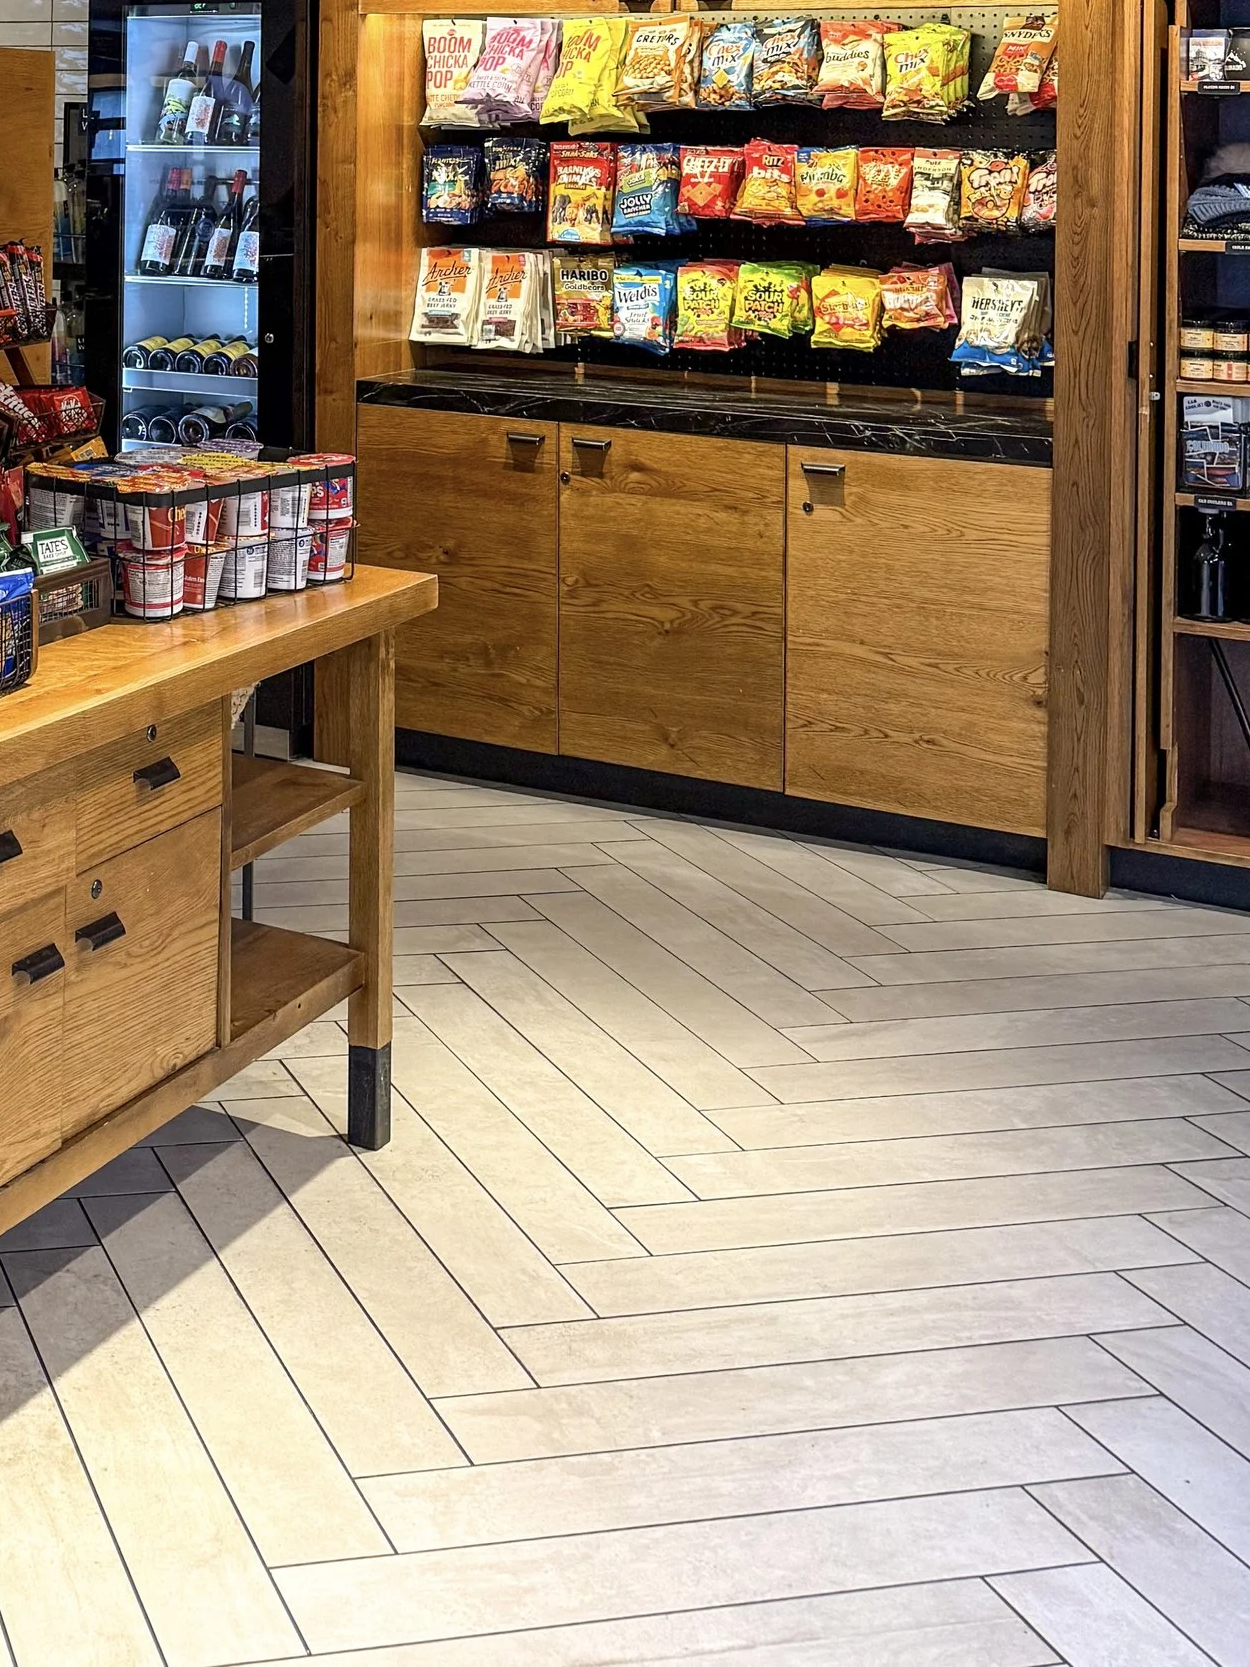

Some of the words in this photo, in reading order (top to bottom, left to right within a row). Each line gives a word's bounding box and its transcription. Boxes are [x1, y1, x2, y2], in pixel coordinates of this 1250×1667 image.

[428, 36, 472, 54] BOOM
[764, 30, 798, 48] Chex
[708, 41, 742, 57] Chex
[825, 49, 870, 63] buddies
[894, 45, 930, 63] Chex
[427, 55, 468, 69] CHICKA
[427, 70, 453, 89] POP
[761, 155, 785, 166] RITZ
[751, 167, 791, 182] bits
[620, 194, 652, 208] JOLLY
[423, 261, 474, 285] Archer
[487, 267, 528, 290] Archer
[561, 269, 608, 281] HARIBO
[565, 283, 605, 291] Goldbears
[747, 290, 783, 302] SOUR
[684, 299, 719, 311] PATCH
[744, 300, 783, 313] PATCH
[38, 539, 70, 553] TATE'S
